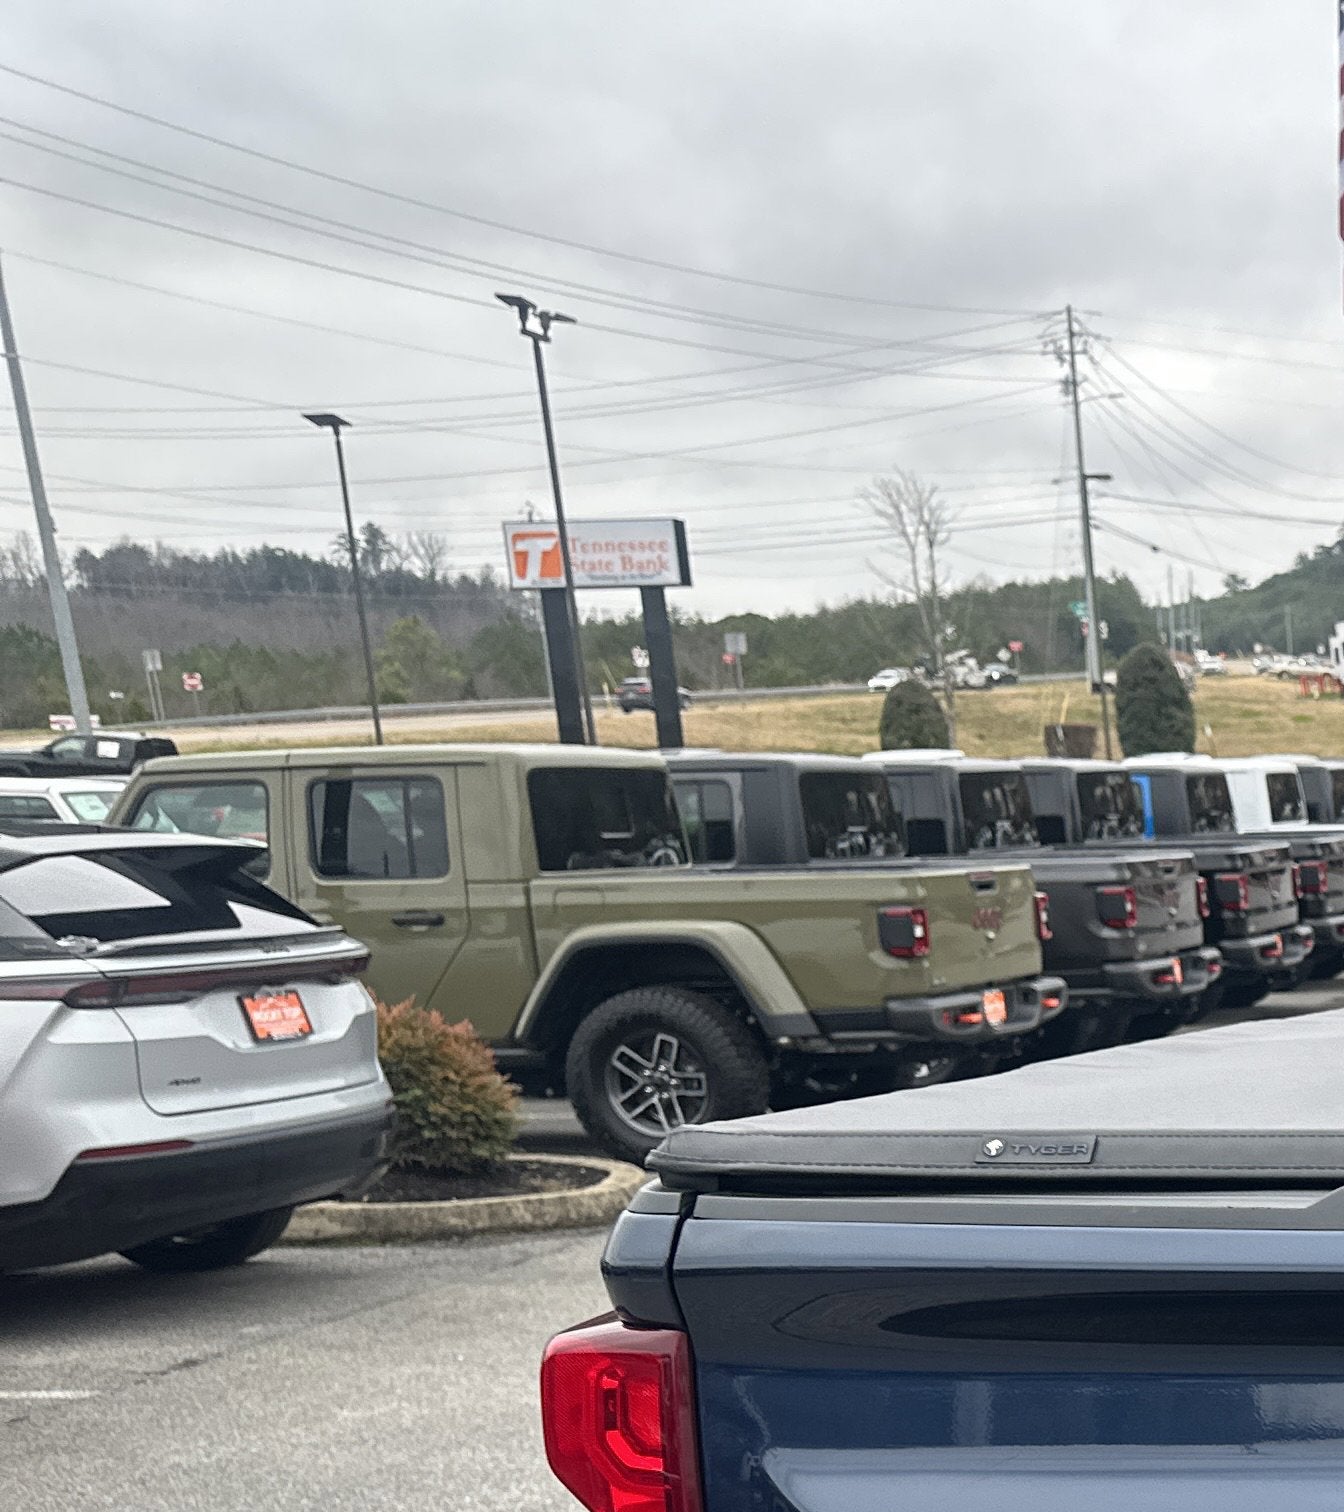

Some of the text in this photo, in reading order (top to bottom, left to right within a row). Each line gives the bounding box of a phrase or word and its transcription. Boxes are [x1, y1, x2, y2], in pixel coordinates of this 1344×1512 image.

[568, 536, 669, 554] Tennessee
[619, 554, 670, 573] Bank
[1011, 1143, 1088, 1156] TYGER
